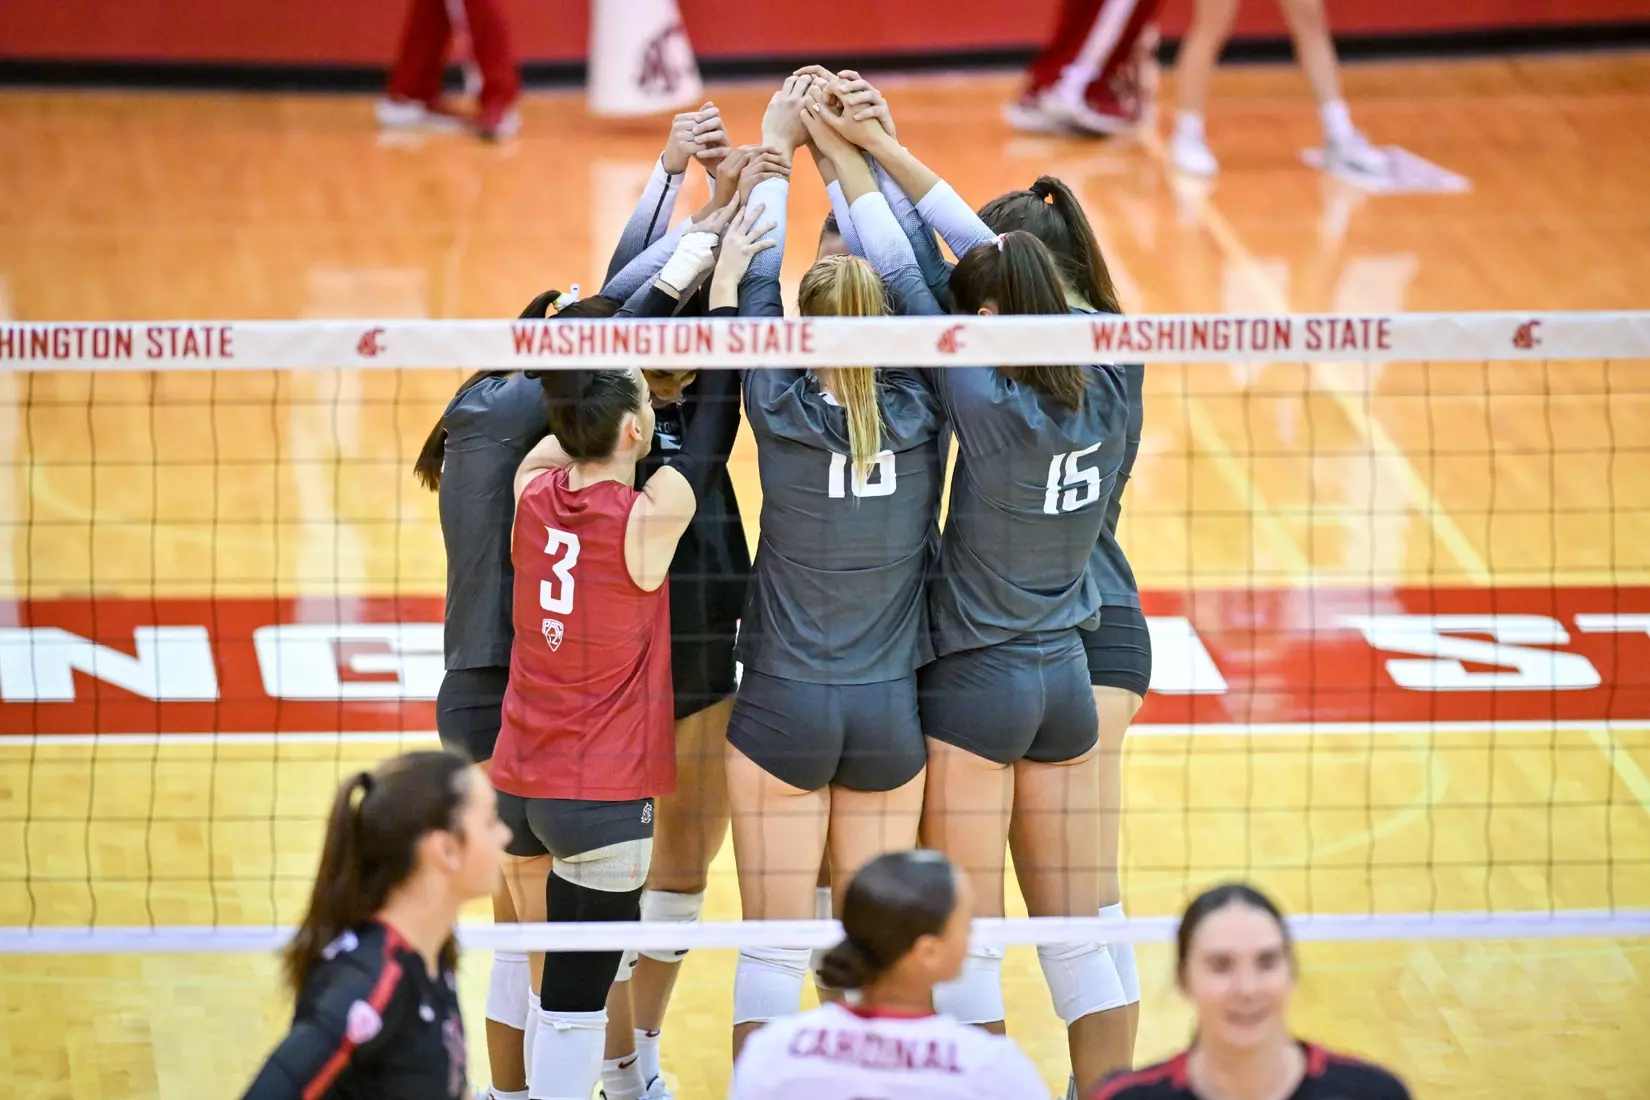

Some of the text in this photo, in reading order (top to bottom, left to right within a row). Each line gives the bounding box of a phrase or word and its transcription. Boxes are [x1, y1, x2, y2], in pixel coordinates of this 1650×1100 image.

[146, 326, 233, 358] STATE
[512, 322, 815, 355] WASHINGTON STATE
[1091, 318, 1392, 352] WASHINGTON STATE
[828, 450, 896, 498] 10
[1043, 442, 1102, 514] 15
[540, 526, 580, 615] 3
